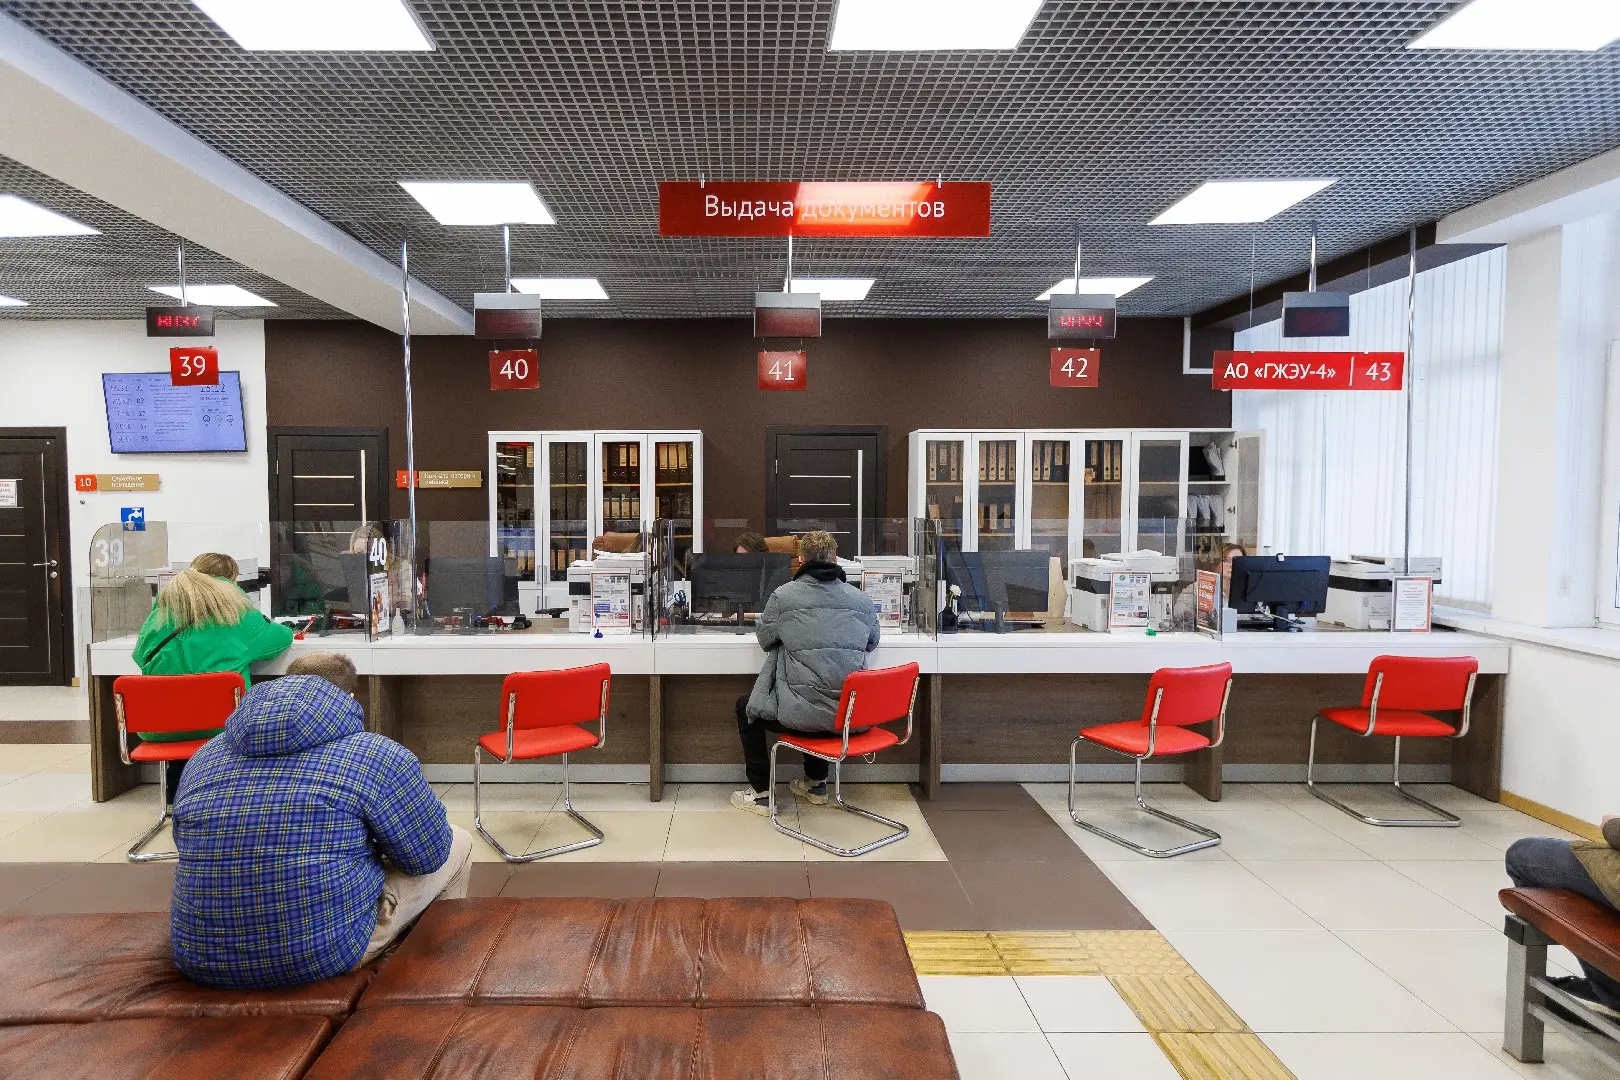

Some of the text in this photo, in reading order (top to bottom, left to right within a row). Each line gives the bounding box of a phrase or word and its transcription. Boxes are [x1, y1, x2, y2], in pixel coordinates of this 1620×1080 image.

[705, 195, 945, 223] Выдача документов
[179, 355, 207, 377] 39
[500, 359, 529, 380] 40
[768, 360, 795, 381] 41
[1060, 357, 1088, 378] 42
[1223, 362, 1392, 381] АО «ГЖЭУ-4» 43
[80, 477, 92, 487] 10
[95, 539, 123, 567] 39
[370, 537, 388, 567] 40
